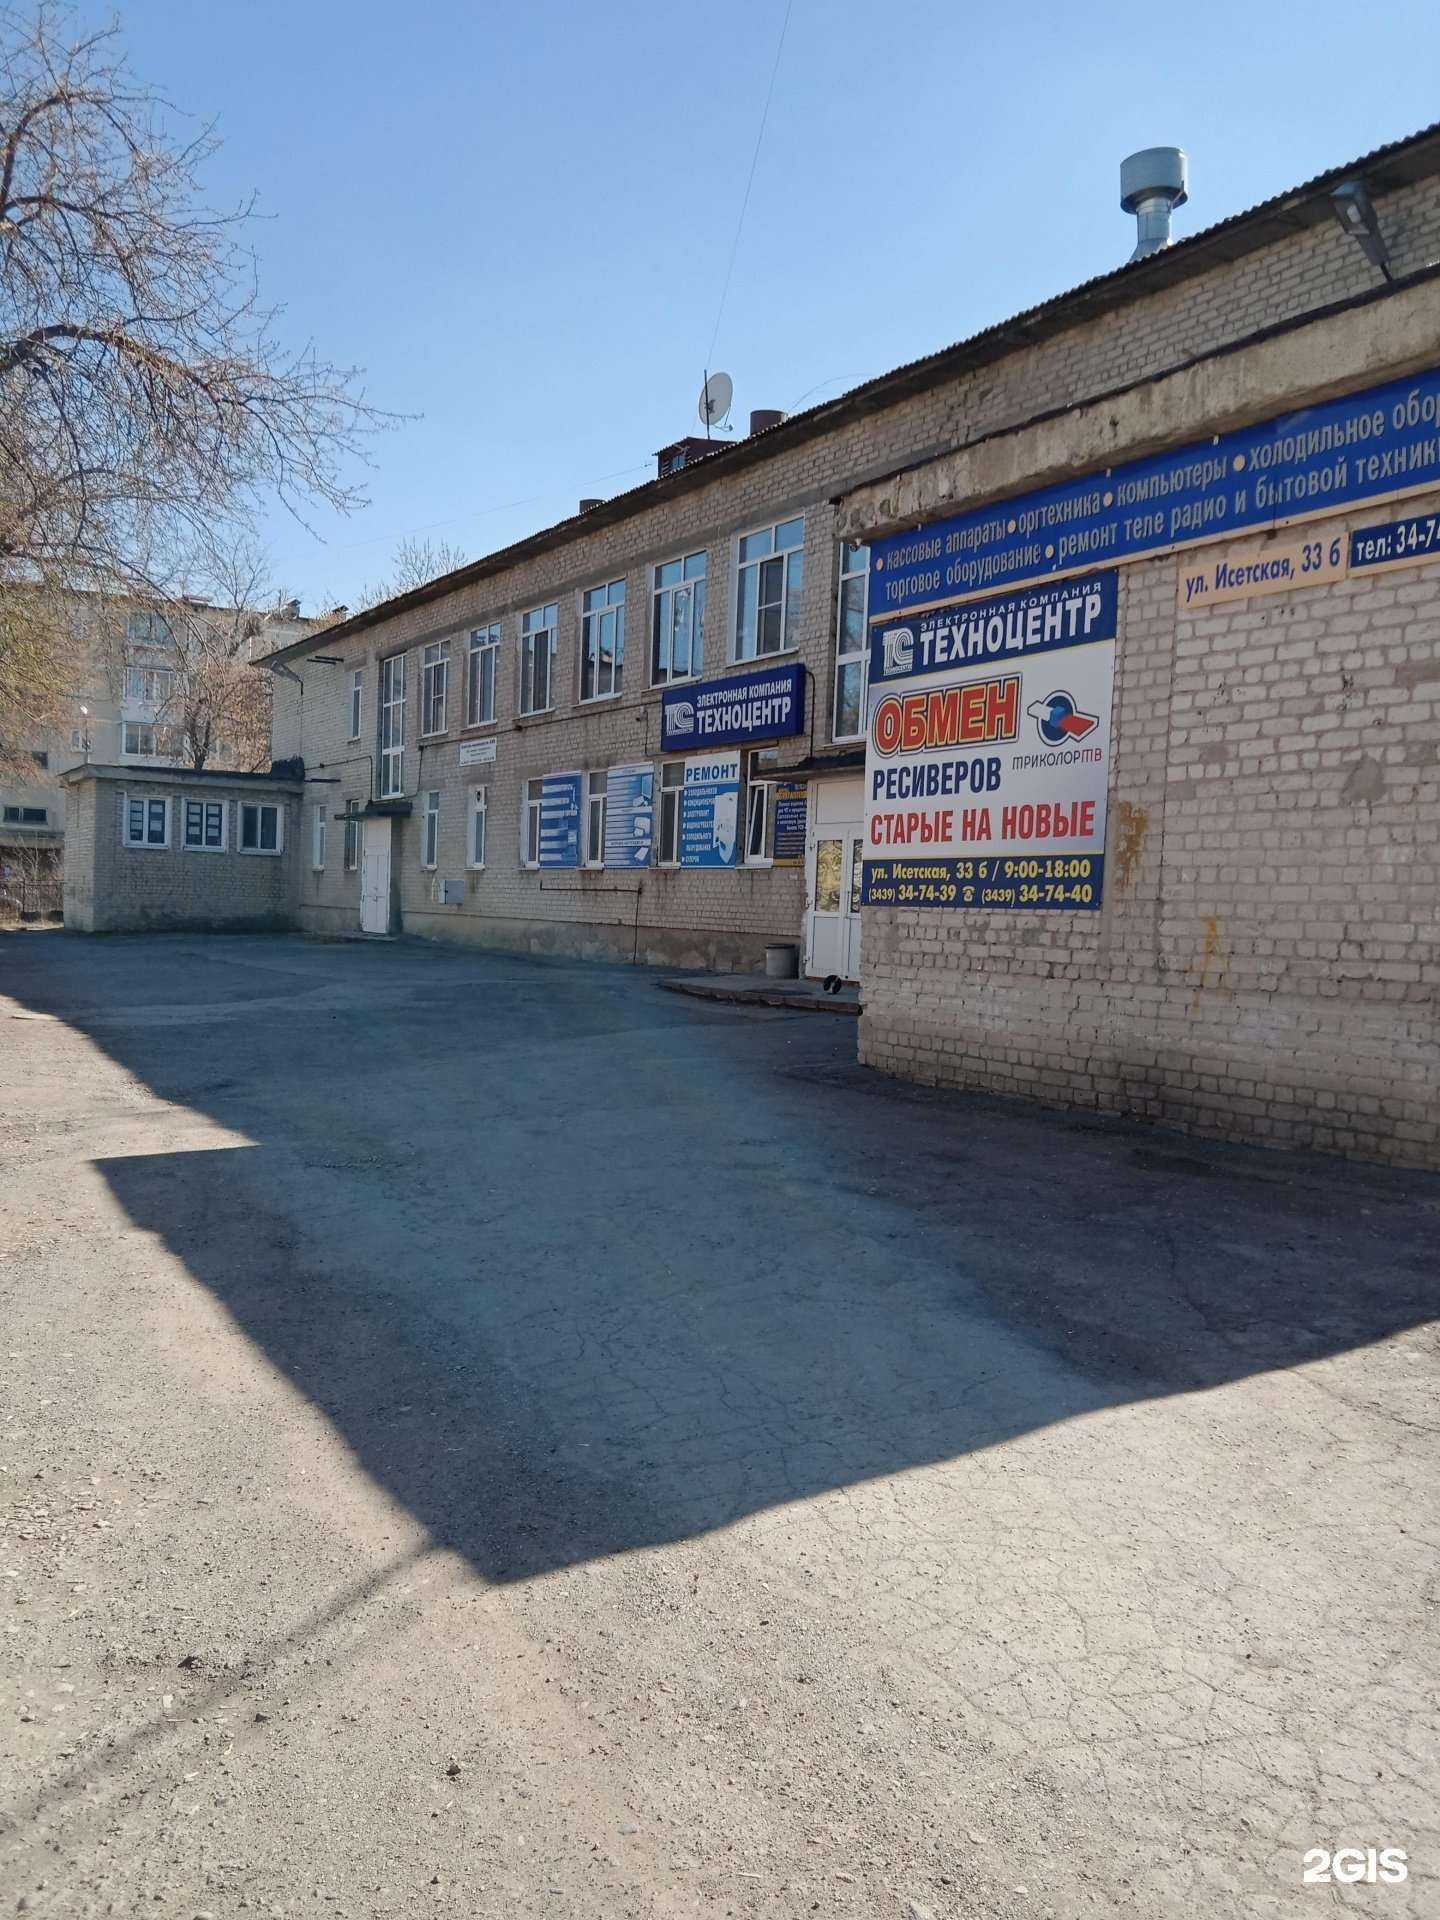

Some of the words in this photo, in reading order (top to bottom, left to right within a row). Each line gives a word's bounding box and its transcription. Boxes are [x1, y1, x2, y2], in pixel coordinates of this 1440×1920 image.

[887, 537, 941, 571] кассовые
[946, 520, 1006, 554] аппараты
[1018, 492, 1100, 539] оргтехника
[1117, 456, 1227, 507] компьютеры
[1249, 411, 1385, 471] холодильное
[886, 570, 940, 604] торговое
[946, 543, 1041, 587] оборудование
[1059, 522, 1118, 564] ремонт
[1124, 512, 1164, 541] теле
[1170, 495, 1226, 538] радио
[1235, 489, 1247, 514] и
[1256, 456, 1347, 509] бытовой
[1355, 437, 1440, 484] техник
[1356, 535, 1391, 560] тел:
[1186, 574, 1208, 602] ул.
[1215, 556, 1295, 590] Исетская,
[1301, 543, 1322, 572] 33
[920, 603, 1016, 632] ЭЛЕКТРОННАЯ
[1020, 582, 1102, 610] КОМПАНИЯ
[920, 594, 1102, 666] ТЕХНОЦЕНТР
[697, 686, 748, 708] ЭЛЕКТРОННАЯ
[749, 678, 792, 699] КОМПАНИЯ
[697, 696, 792, 734] ТЕХНОЦЕНТР
[874, 678, 1019, 754] ОБМЕН
[686, 763, 738, 781] РЕМОНТ
[872, 757, 1001, 800] РЕСИВЕРОВ
[871, 810, 953, 845] СТАРЫЕ
[962, 808, 991, 841] НА
[1001, 801, 1096, 840] НОВЫЕ
[871, 865, 888, 883] ул.
[892, 863, 951, 882] Исетская,
[956, 862, 974, 879] 33
[992, 860, 1000, 882] /
[1004, 859, 1091, 879] 9:00-18:00
[868, 887, 896, 902] (3439)
[898, 885, 957, 902] 34-74-39
[981, 888, 1015, 904] (3439)
[1018, 884, 1092, 903] 34-74-40
